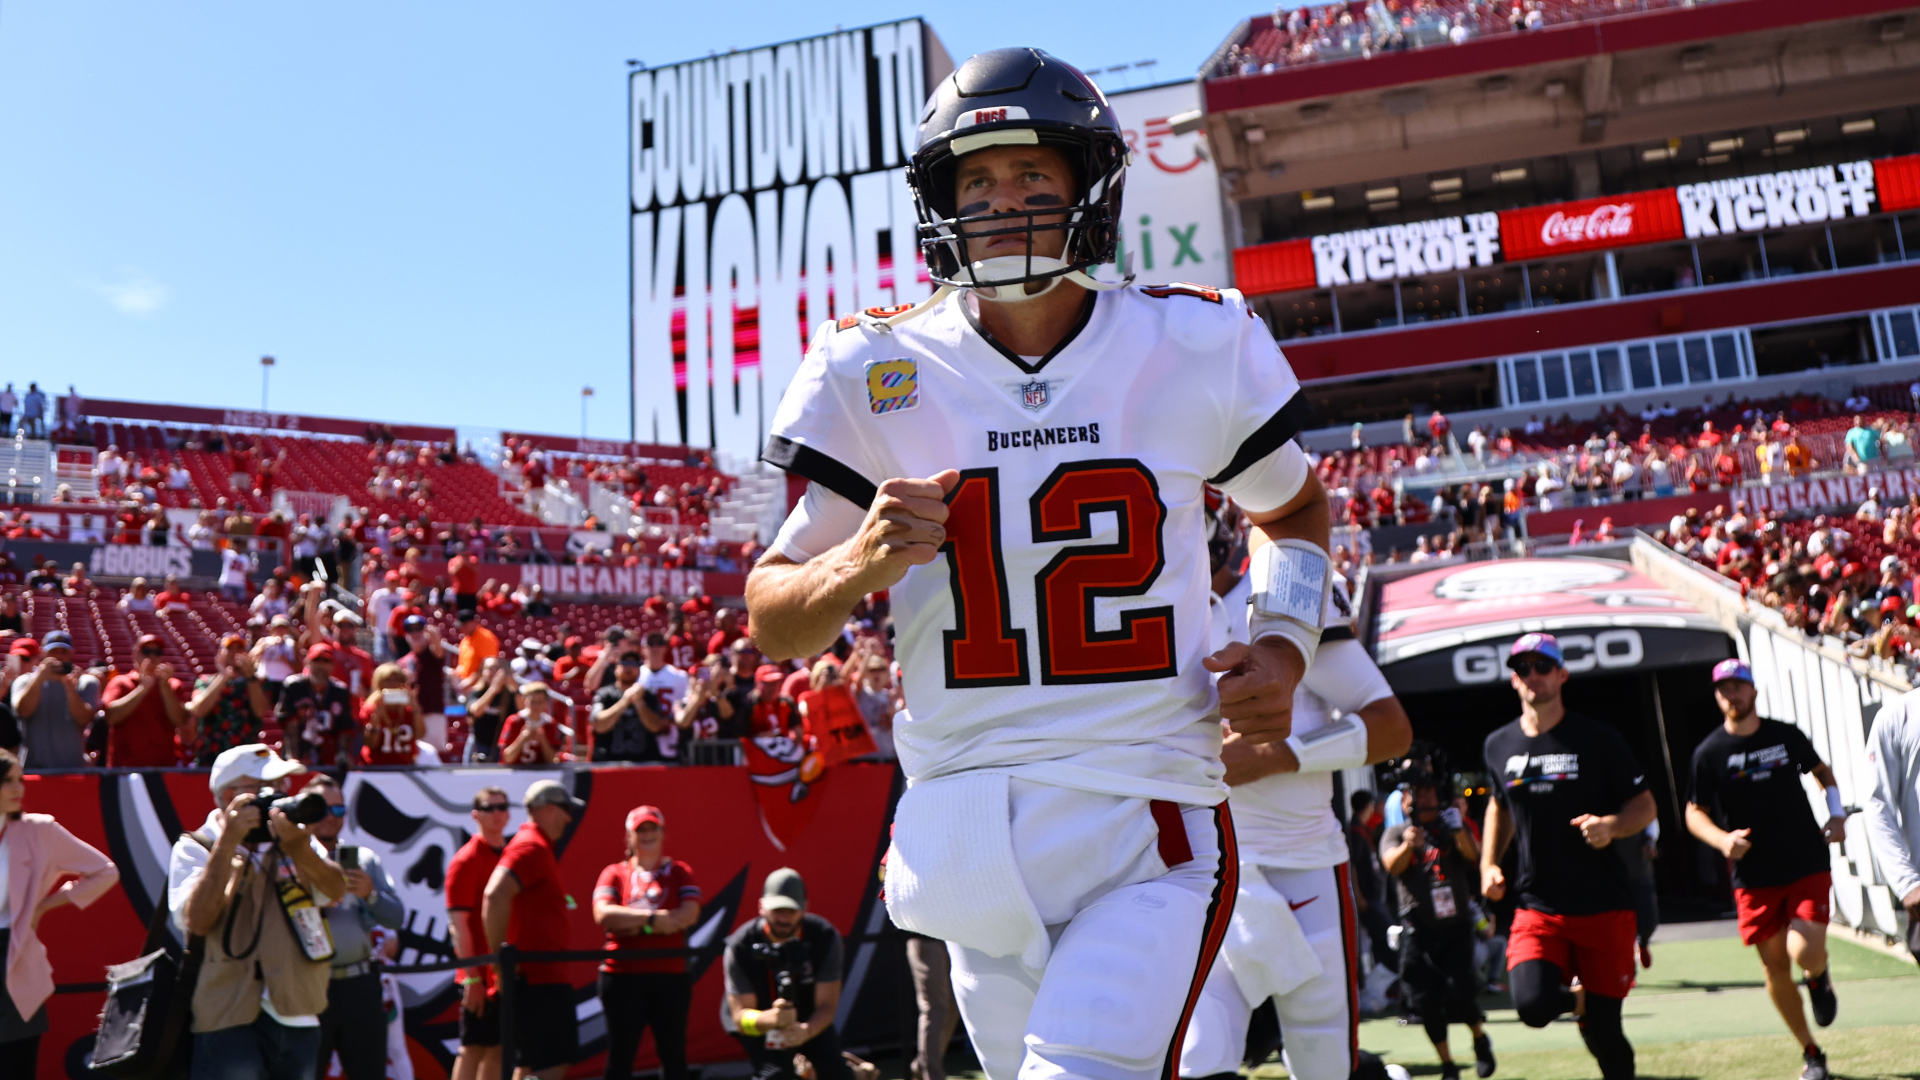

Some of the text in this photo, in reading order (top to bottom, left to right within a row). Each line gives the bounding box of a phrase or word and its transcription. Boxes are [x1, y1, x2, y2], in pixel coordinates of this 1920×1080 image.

[631, 18, 925, 211] COUNTDOWN TO
[1676, 160, 1874, 203] COUNTDOWN TO
[1541, 202, 1635, 246] Coca-Cola
[1680, 178, 1876, 239] KICKOFF
[1311, 211, 1500, 251] COUNTDOWN TO
[1314, 229, 1500, 288] KICKOFF
[1025, 391, 1046, 405] NFL
[223, 410, 279, 429] NEST
[986, 422, 1100, 452] BUCCANEERS
[90, 544, 193, 578] #GOBUCS
[520, 563, 704, 596] BUCCANEERS
[940, 458, 1178, 689] 12
[1452, 628, 1644, 684] GCO
[380, 723, 413, 753] 12
